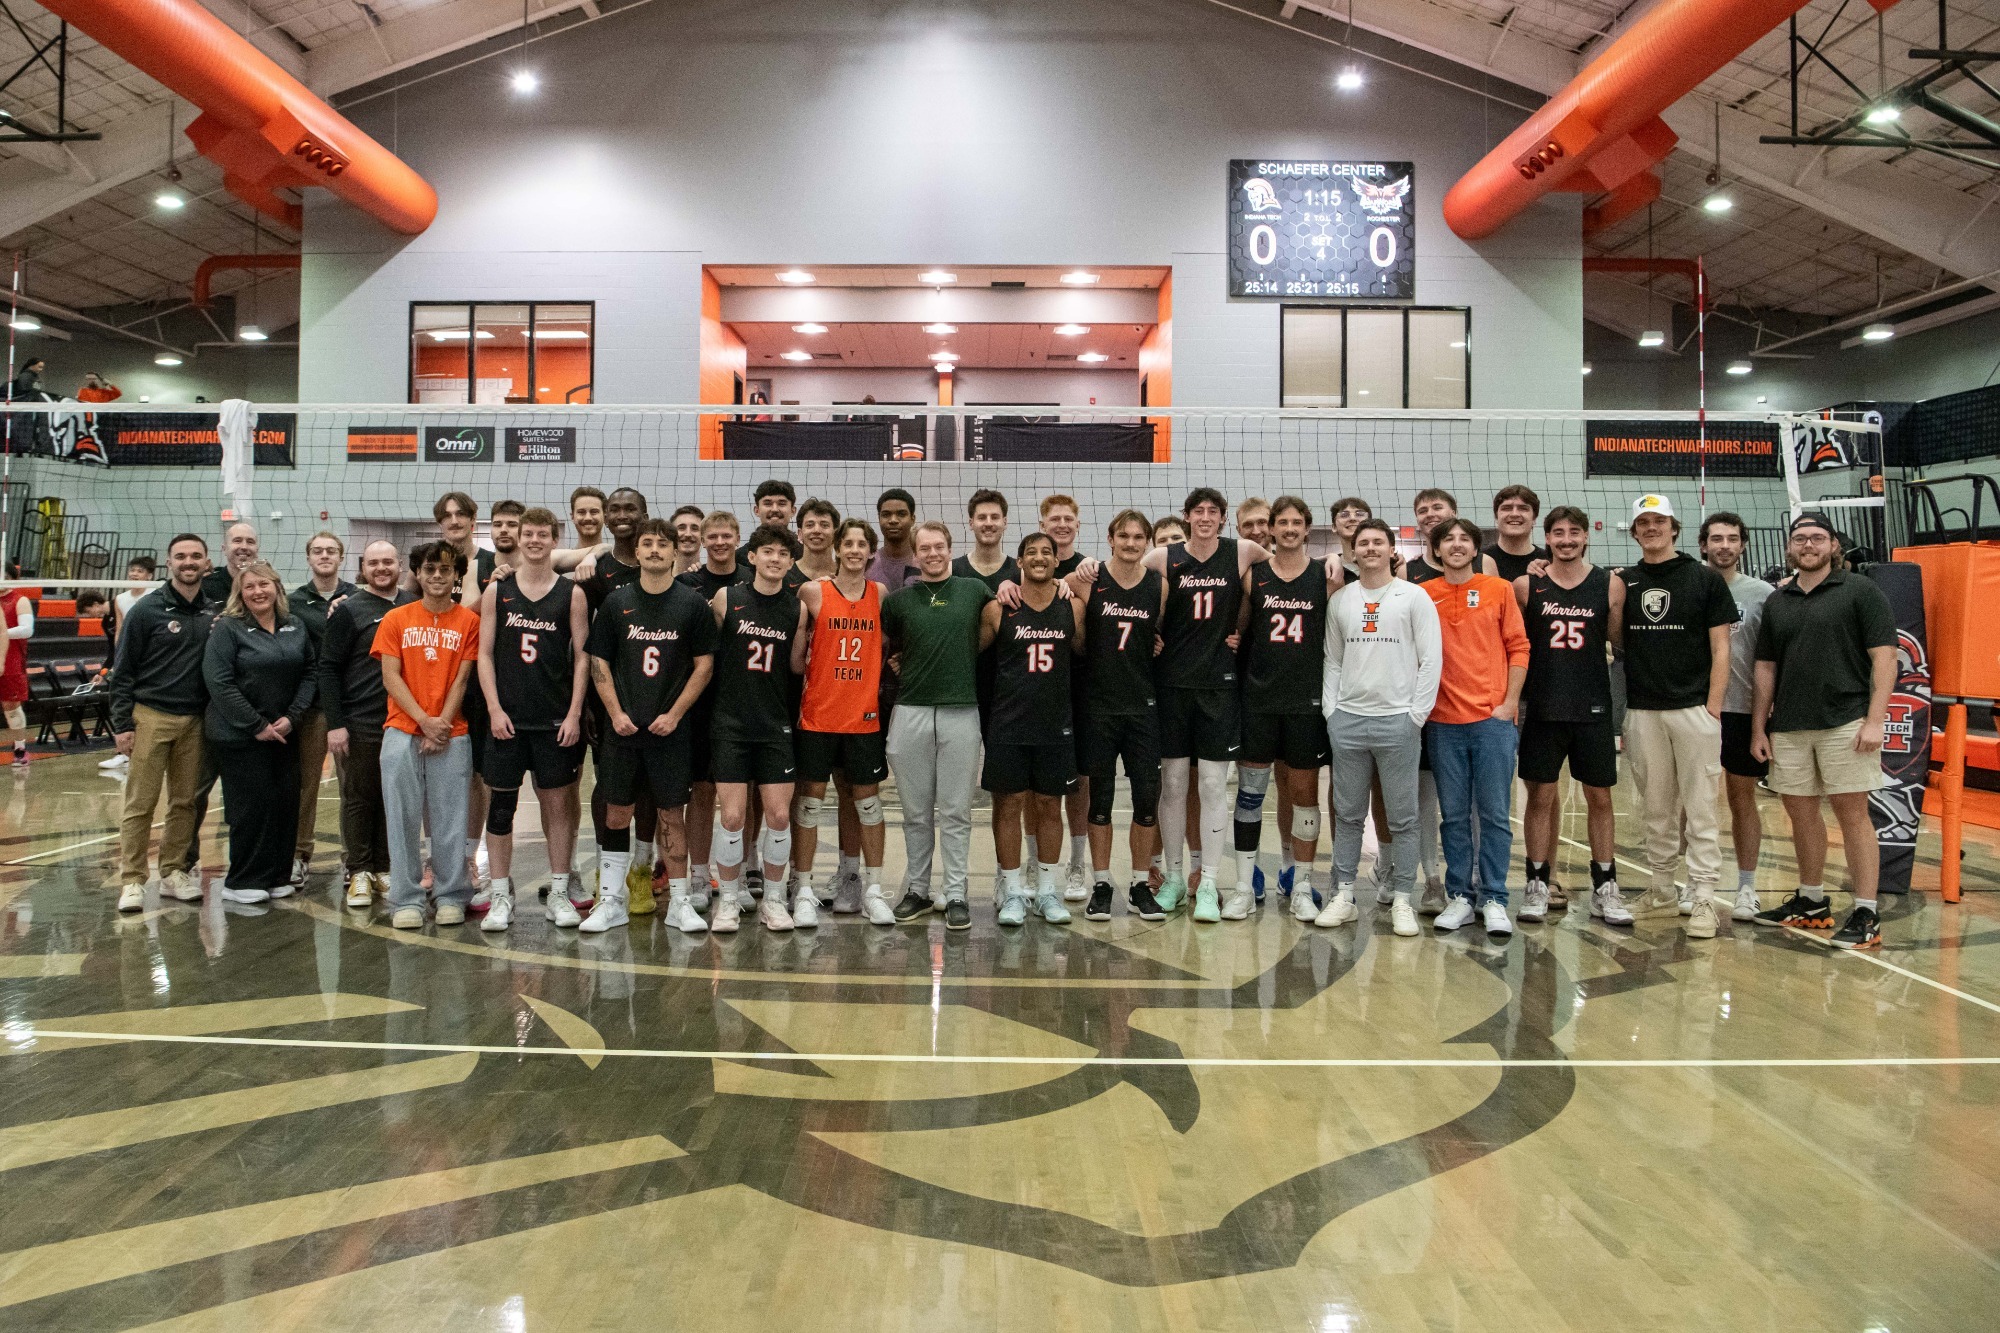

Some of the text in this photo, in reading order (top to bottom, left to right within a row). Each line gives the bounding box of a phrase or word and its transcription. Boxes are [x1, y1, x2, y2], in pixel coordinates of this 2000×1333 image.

[1258, 163, 1385, 176] SCHAEFER CENTER
[1304, 190, 1341, 206] 1:15
[1250, 225, 1277, 265] 0
[1311, 236, 1332, 246] SET
[1369, 227, 1397, 267] 0
[1316, 246, 1326, 260] 4
[1245, 281, 1278, 293] 25:14
[1286, 282, 1318, 294] 25:21
[1326, 282, 1359, 294] 25:15
[435, 437, 477, 450] Omni
[528, 444, 561, 454] Hilton
[1178, 574, 1227, 588] Warriors
[1101, 601, 1150, 619] Warriors
[1192, 591, 1214, 620] 11
[1262, 594, 1314, 610] Warriors
[1541, 601, 1595, 617] Warriors
[505, 611, 557, 631] Warriors
[828, 617, 875, 631] INDIANA
[1270, 613, 1304, 643] 24
[627, 624, 679, 640] Warriors
[736, 619, 787, 640] Warriors
[1014, 625, 1066, 640] Warriors
[1117, 621, 1133, 651] 7
[1550, 620, 1586, 650] 25
[401, 631, 439, 649] INDIANA
[521, 633, 538, 664] 5
[747, 640, 774, 673] 21
[837, 637, 862, 661] 12
[643, 646, 660, 677] 6
[1026, 643, 1054, 673] 15
[834, 667, 863, 681] TECH
[1884, 724, 1910, 732] TECH
